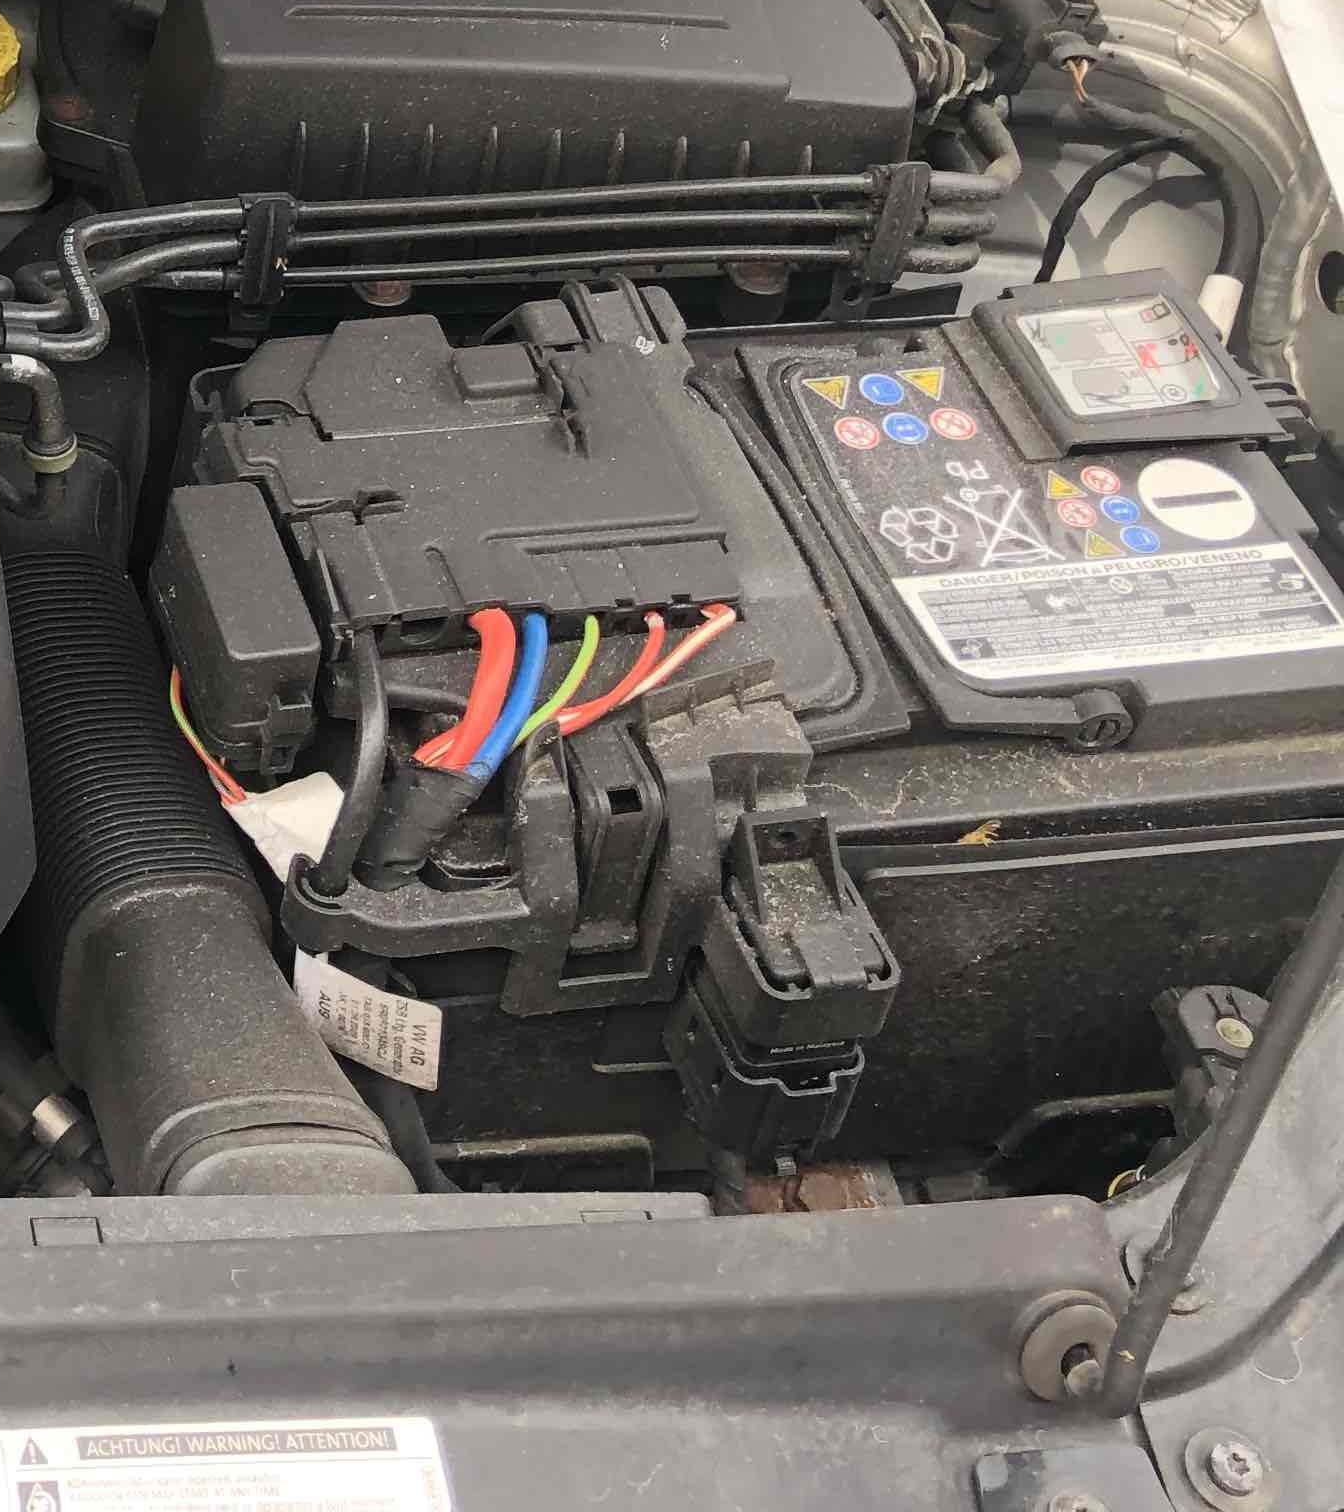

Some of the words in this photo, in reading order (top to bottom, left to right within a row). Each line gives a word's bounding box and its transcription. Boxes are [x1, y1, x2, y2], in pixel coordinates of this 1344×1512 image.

[944, 457, 991, 485] Pb
[939, 566, 1088, 588] DANGER/POISON
[1103, 550, 1263, 573] PELIGRO/VENENO
[412, 1024, 427, 1045] VW
[409, 1046, 427, 1067] AG
[86, 1434, 182, 1458] ACHTUNG!
[186, 1431, 282, 1455] WARNING!
[285, 1428, 391, 1452] ATTENTION!
